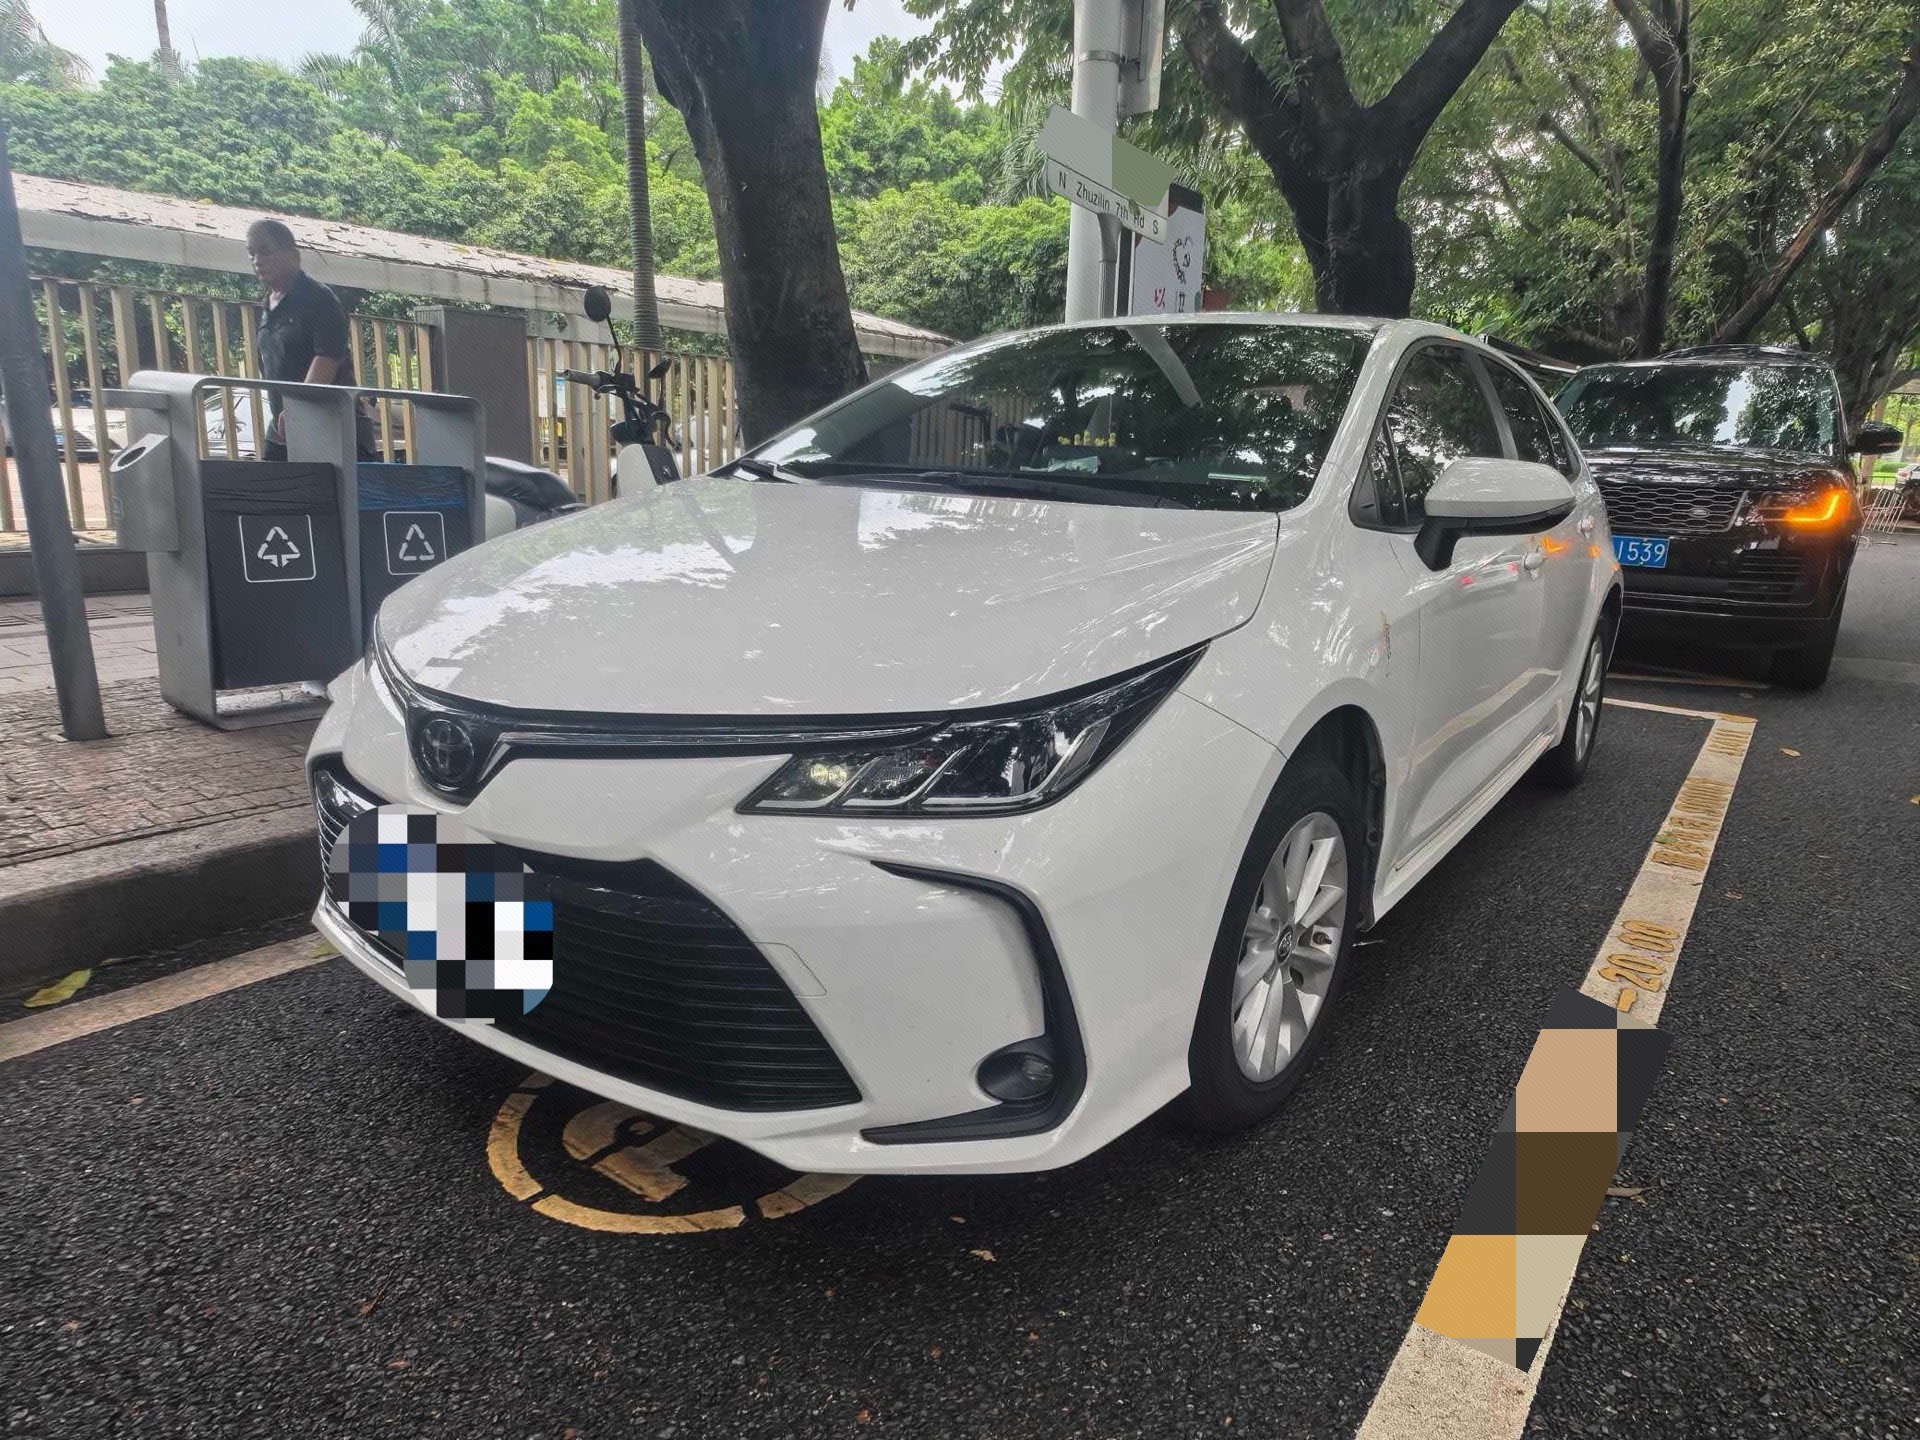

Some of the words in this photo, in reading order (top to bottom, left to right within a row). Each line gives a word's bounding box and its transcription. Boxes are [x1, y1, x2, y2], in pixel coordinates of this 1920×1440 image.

[1058, 171, 1067, 189] N
[1076, 181, 1110, 212] Zhuzilin
[1115, 201, 1129, 221] 7th
[1152, 219, 1159, 235] S
[1617, 540, 1666, 562] 1539
